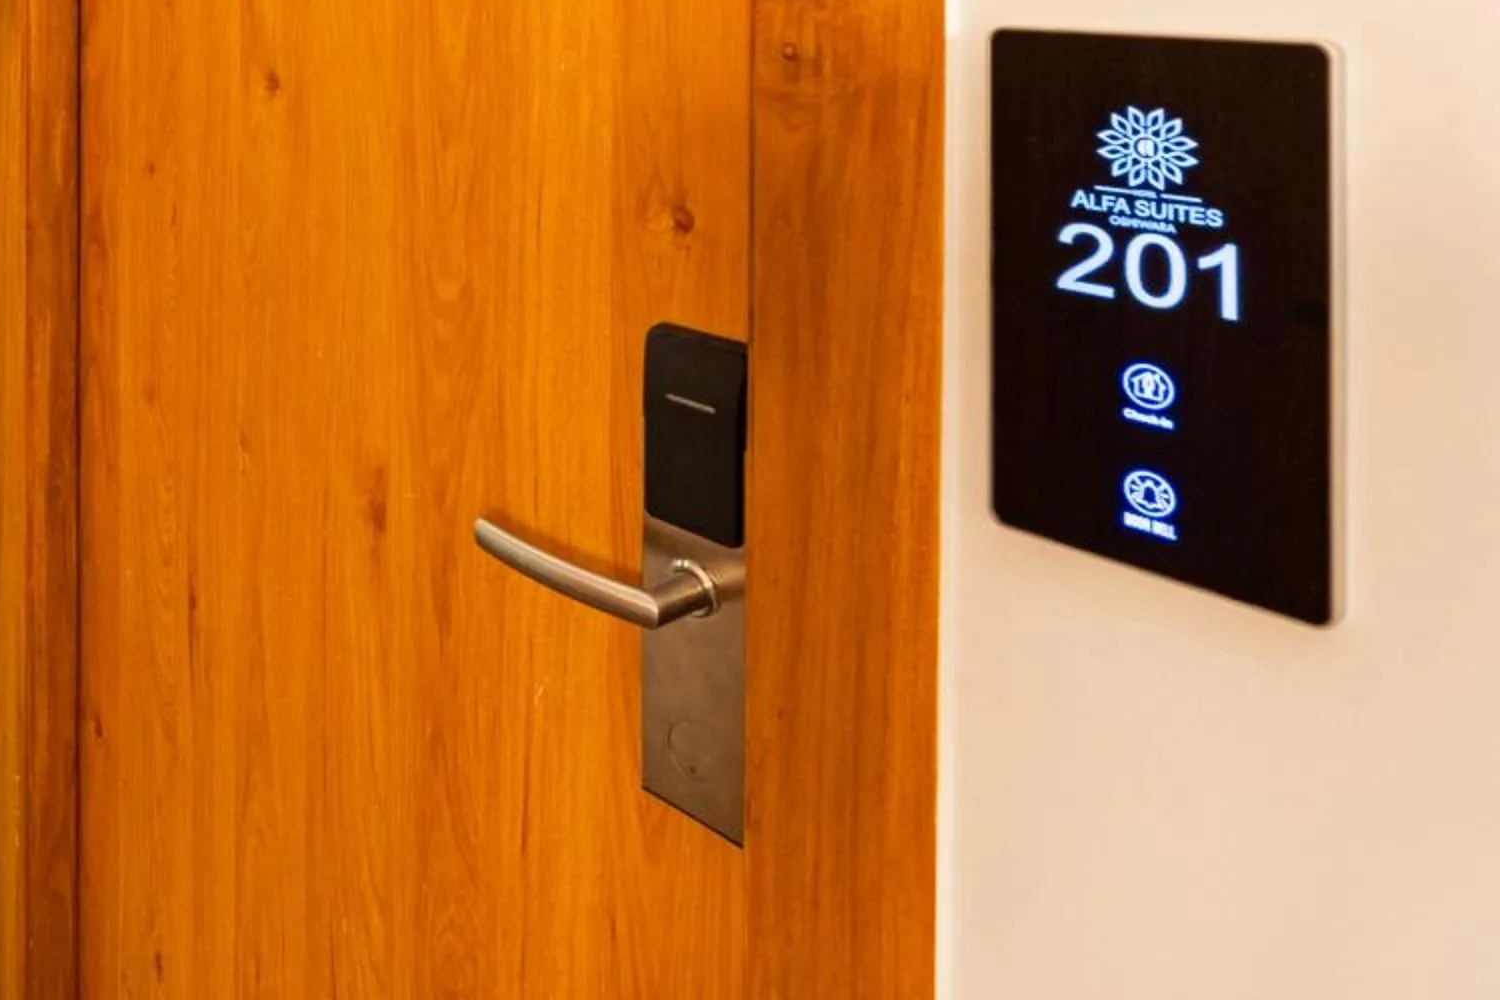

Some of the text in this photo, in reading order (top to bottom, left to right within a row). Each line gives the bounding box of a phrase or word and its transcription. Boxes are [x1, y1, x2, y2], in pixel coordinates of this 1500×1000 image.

[1070, 189, 1224, 227] ALFA SUITES
[1057, 222, 1240, 321] 201
